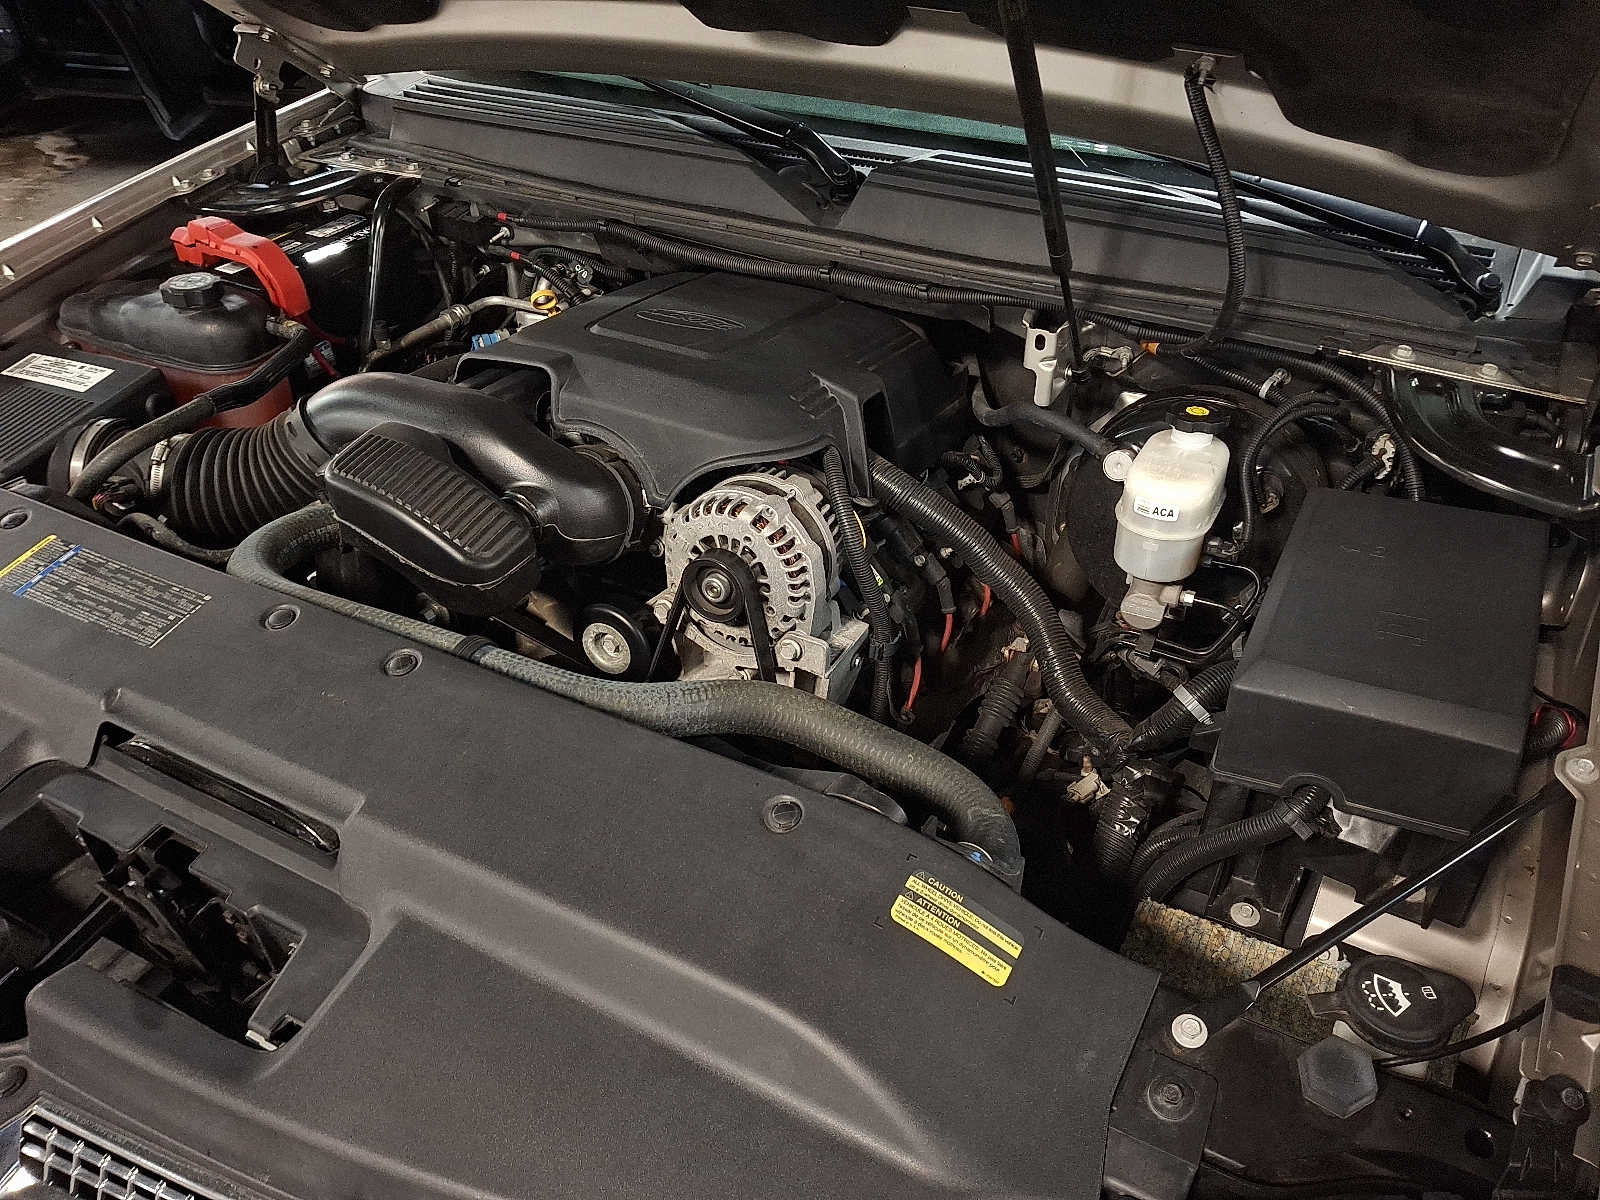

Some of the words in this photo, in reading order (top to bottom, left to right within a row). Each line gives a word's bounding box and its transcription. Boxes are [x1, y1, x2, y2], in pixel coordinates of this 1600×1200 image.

[1152, 506, 1174, 518] ACA
[927, 876, 963, 903] CAUTION
[916, 895, 961, 929] ATTENTION
